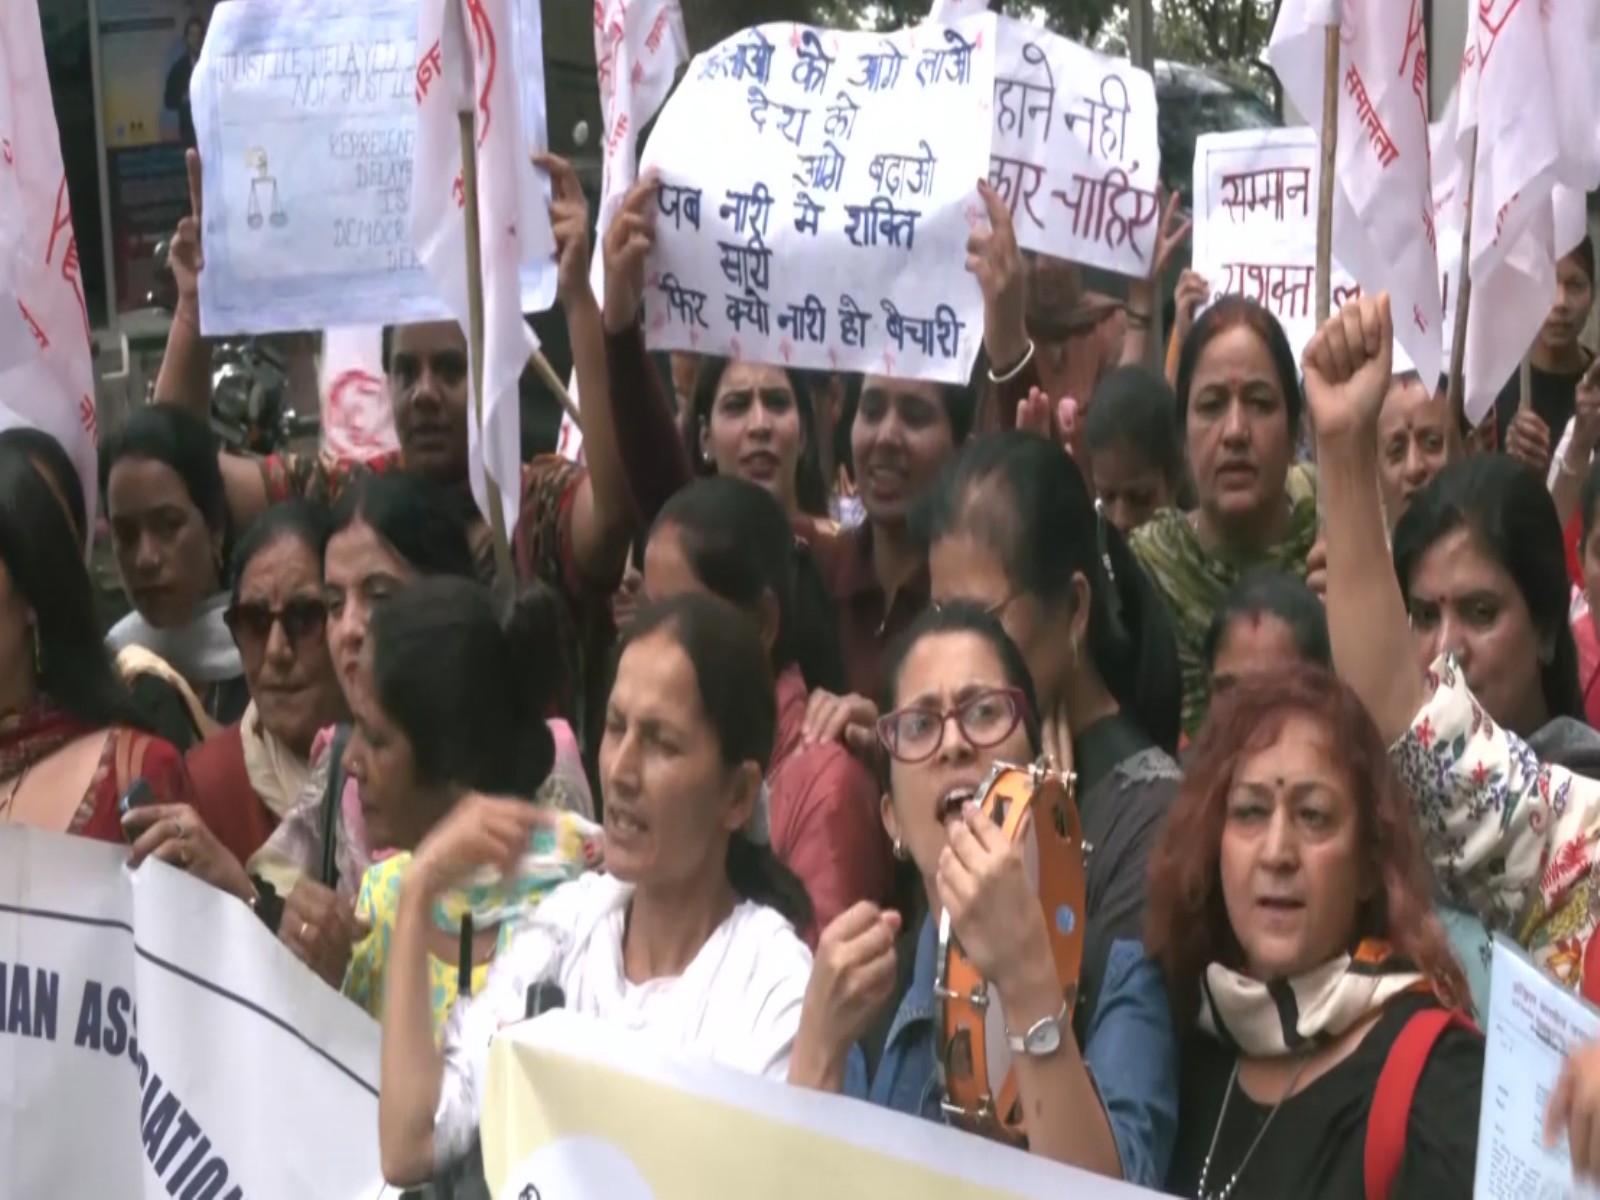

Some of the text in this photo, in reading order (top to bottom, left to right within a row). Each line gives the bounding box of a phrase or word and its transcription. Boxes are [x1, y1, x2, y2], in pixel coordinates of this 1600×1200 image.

[791, 30, 837, 95] को
[824, 91, 861, 140] को
[333, 218, 403, 248] DEMOCR
[656, 184, 703, 232] जब
[719, 182, 776, 236] नारी
[842, 196, 922, 250] शक्ति
[658, 272, 710, 331] फिर
[777, 293, 828, 345] नारी
[837, 292, 874, 352] हो
[879, 297, 967, 360] बेचारी
